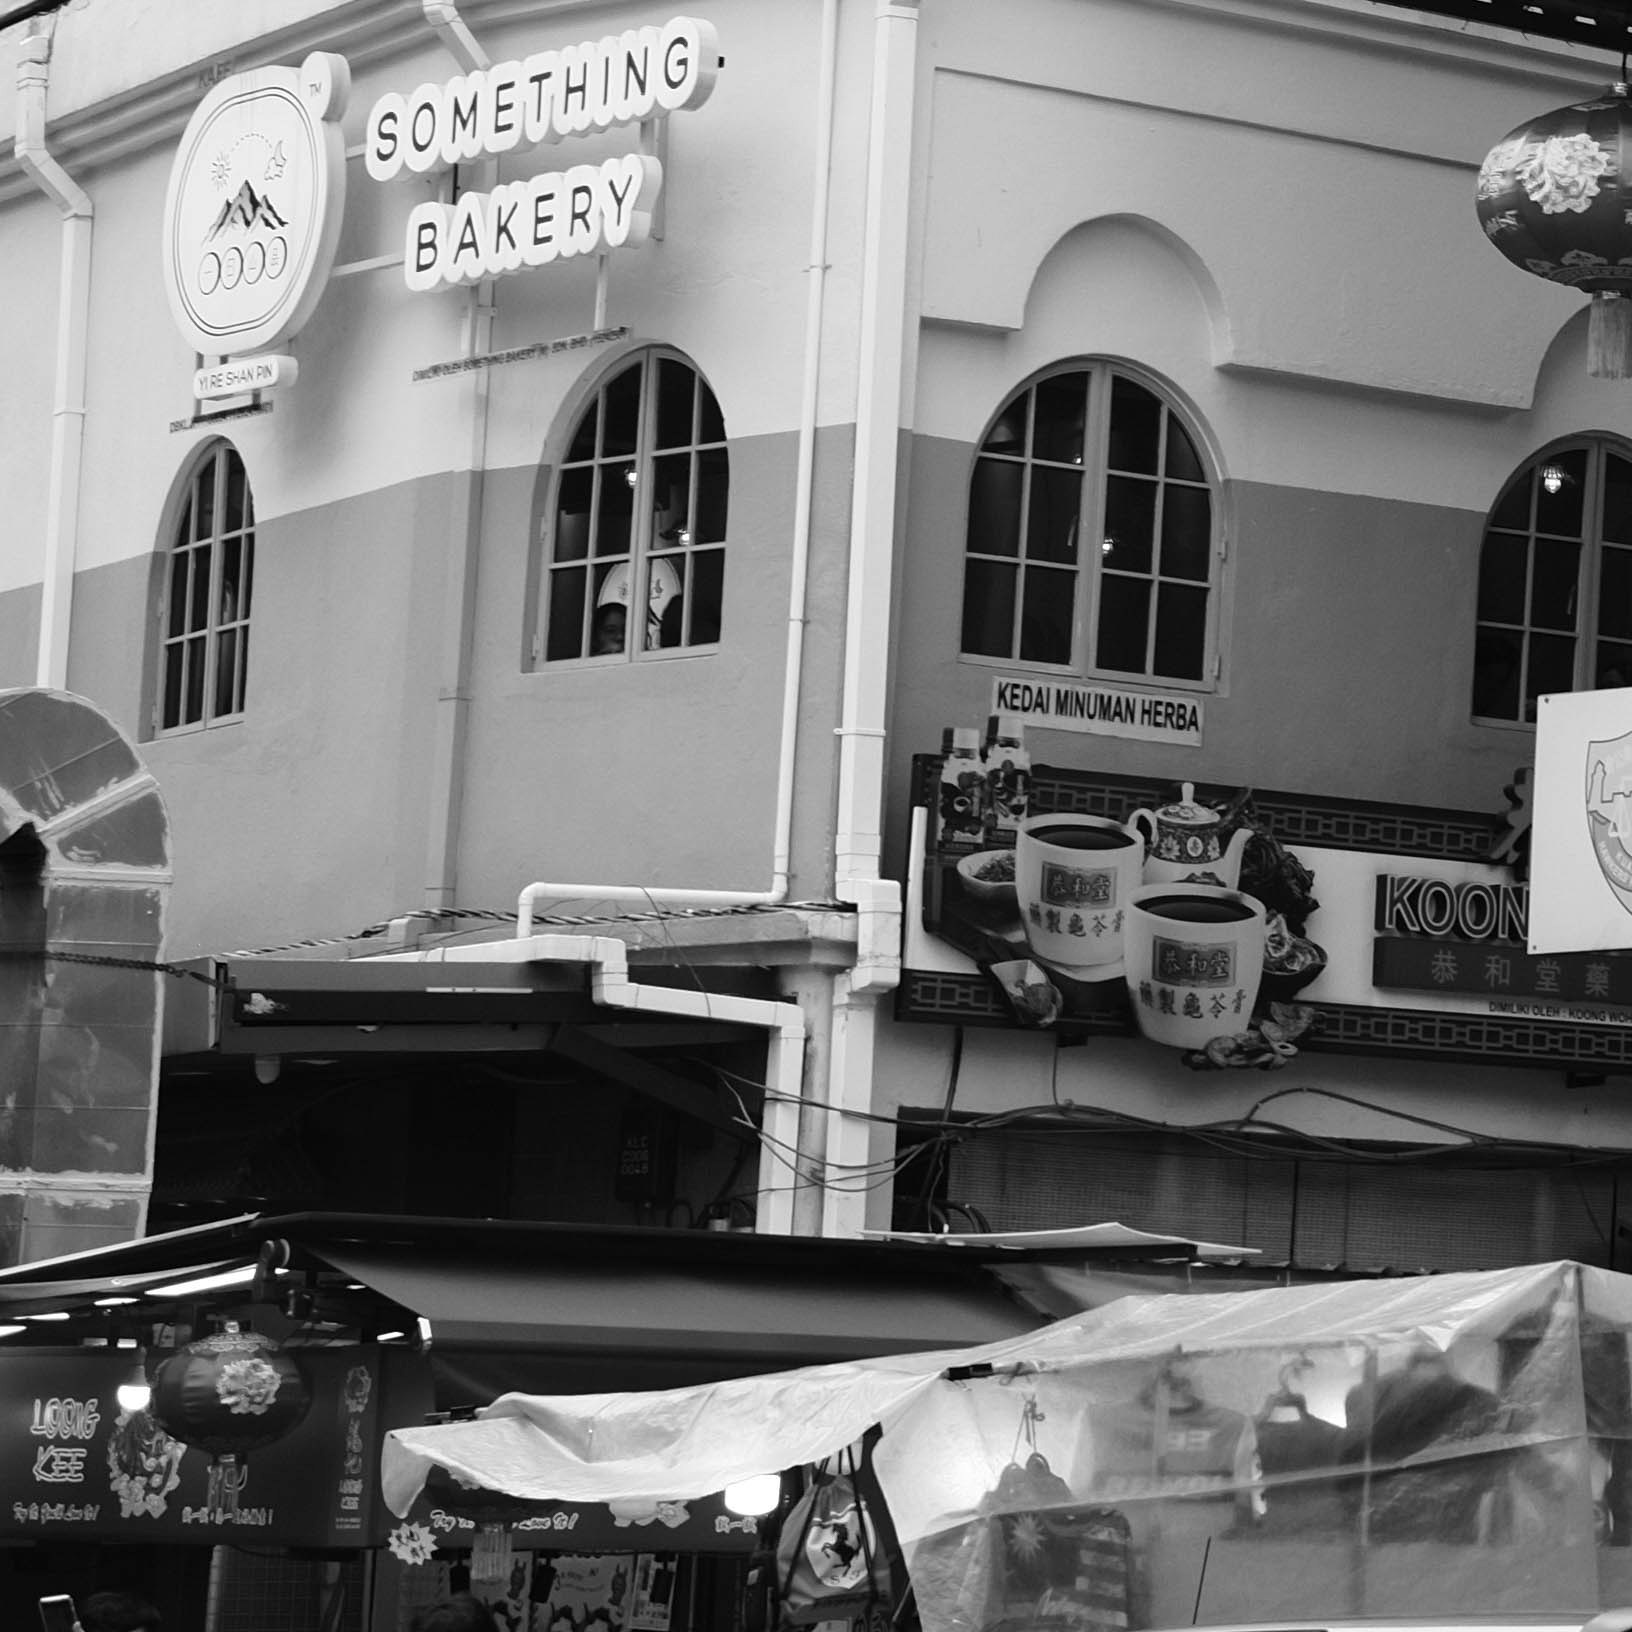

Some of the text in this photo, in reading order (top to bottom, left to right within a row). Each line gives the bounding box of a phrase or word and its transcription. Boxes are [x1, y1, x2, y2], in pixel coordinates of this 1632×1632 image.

[376, 36, 690, 162] SOMETHING
[415, 174, 633, 273] BAKERY
[209, 372, 224, 388] RE
[226, 368, 254, 386] SHAN
[997, 681, 1200, 732] KEDAI MINUMAN HERBA
[1567, 1008, 1606, 1023] KOONG
[30, 1397, 101, 1439] LOONG
[32, 1445, 88, 1482] KEE
